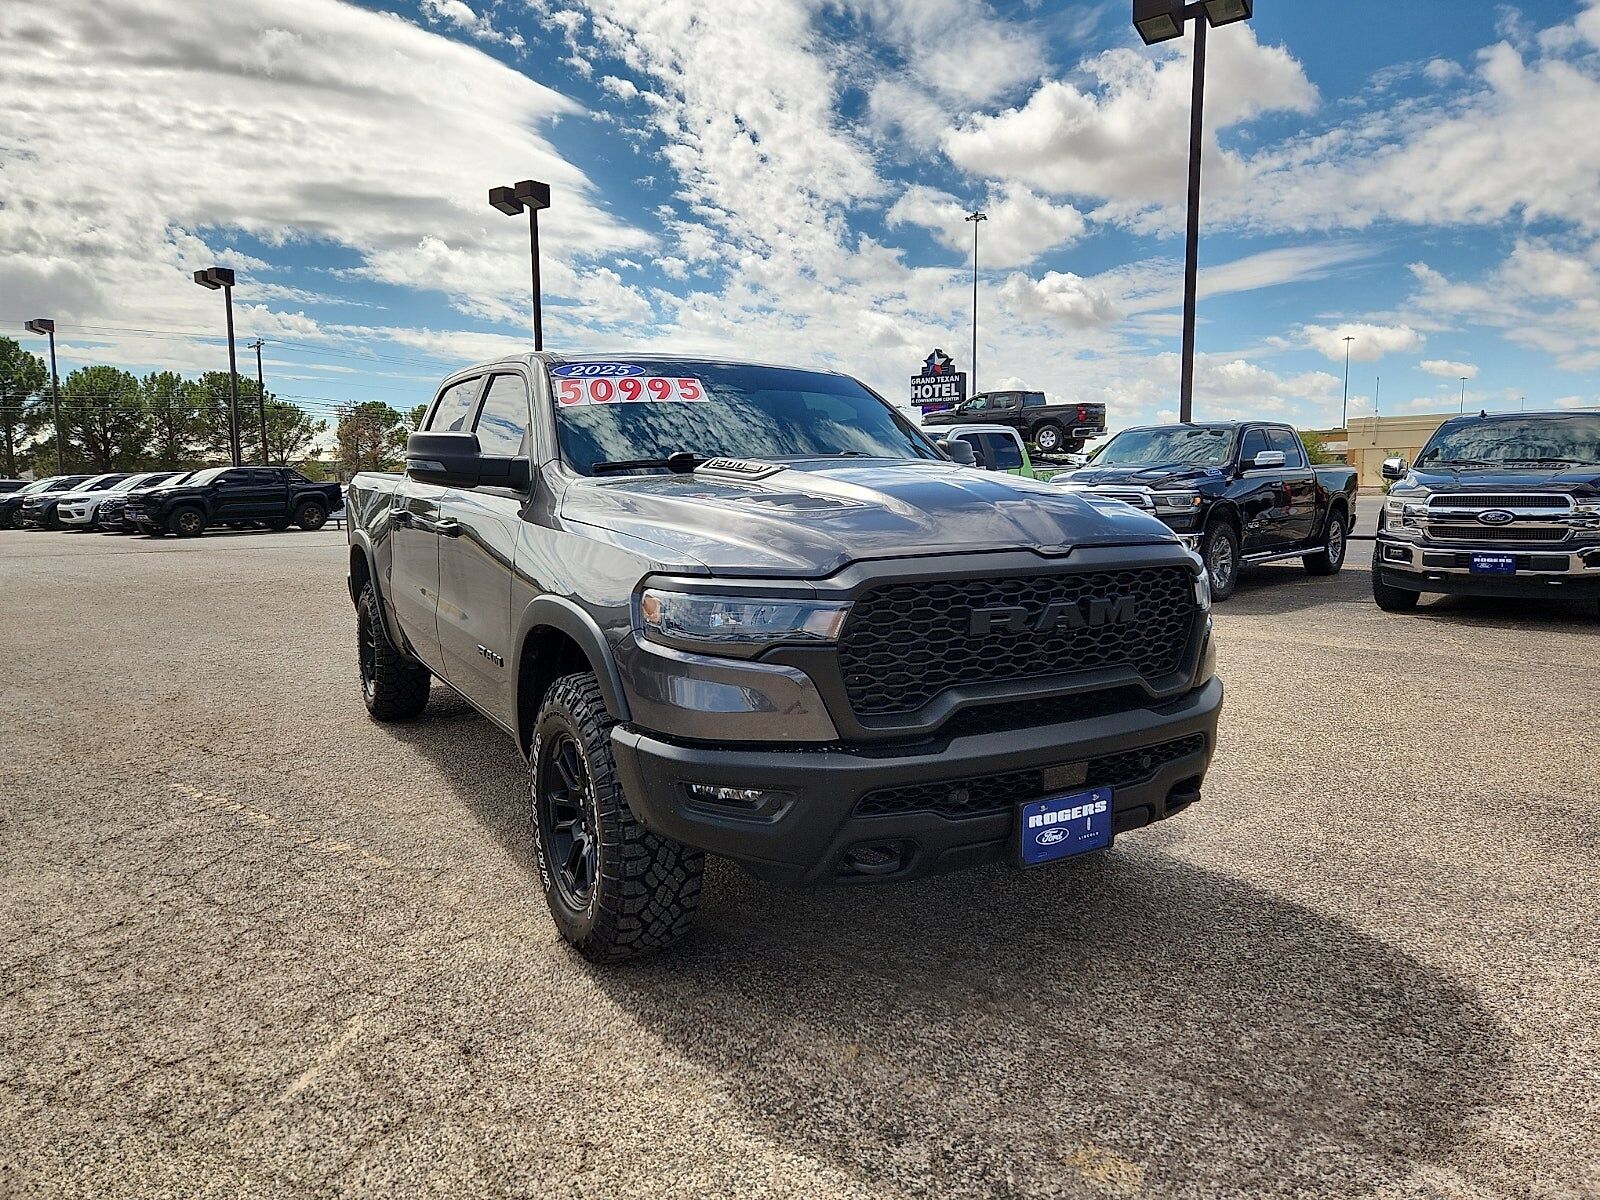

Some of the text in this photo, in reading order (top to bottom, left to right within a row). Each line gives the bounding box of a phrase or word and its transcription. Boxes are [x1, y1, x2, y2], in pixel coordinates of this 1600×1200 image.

[567, 365, 632, 376] 2025
[911, 377, 936, 385] GRAND
[558, 378, 702, 405] 50995
[911, 383, 960, 398] HOTEL
[970, 595, 1136, 636] RAM
[1029, 801, 1107, 828] ROGERS
[1041, 828, 1064, 843] Ford
[1078, 831, 1100, 841] LINCOLN
